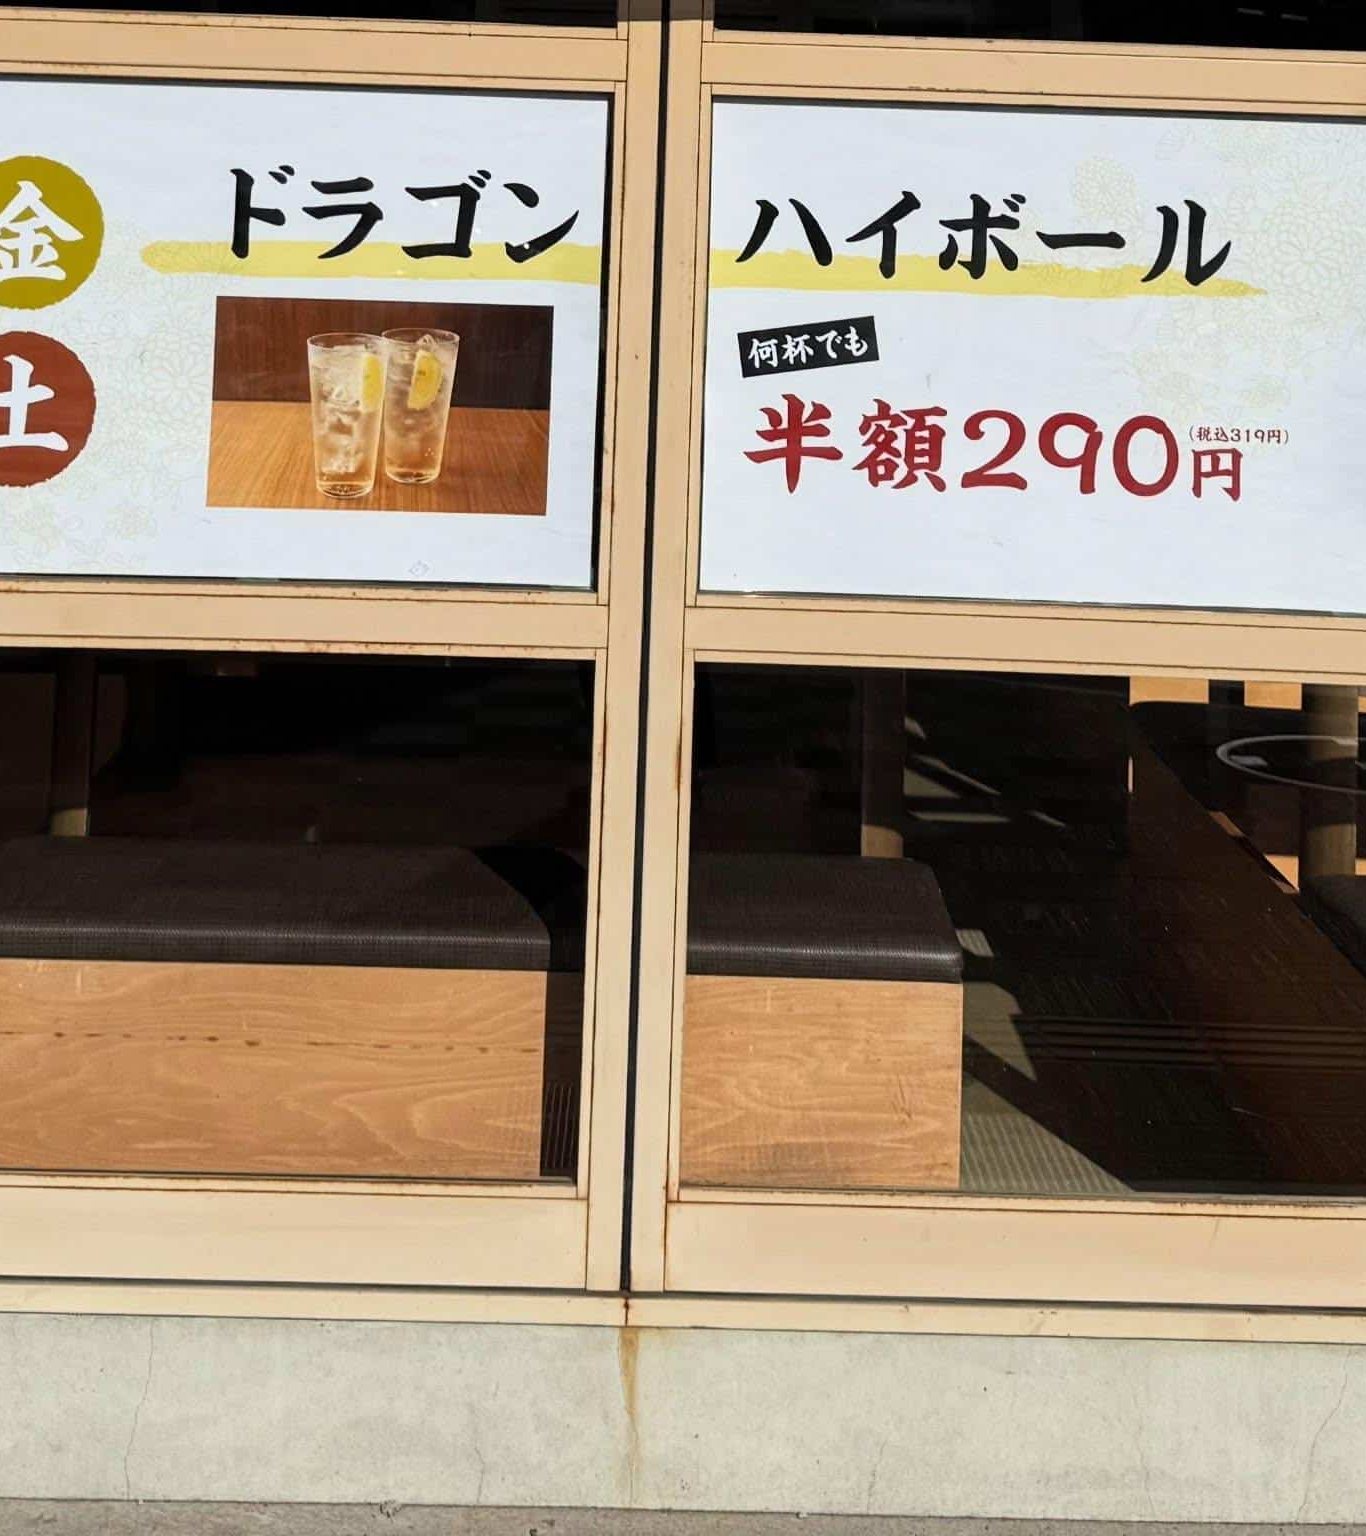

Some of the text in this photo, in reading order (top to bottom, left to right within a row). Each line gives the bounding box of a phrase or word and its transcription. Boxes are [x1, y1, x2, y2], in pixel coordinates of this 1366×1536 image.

[230, 165, 580, 264] ドラゴン
[735, 190, 1232, 287] ハイボール
[748, 326, 869, 368] 何杯でも
